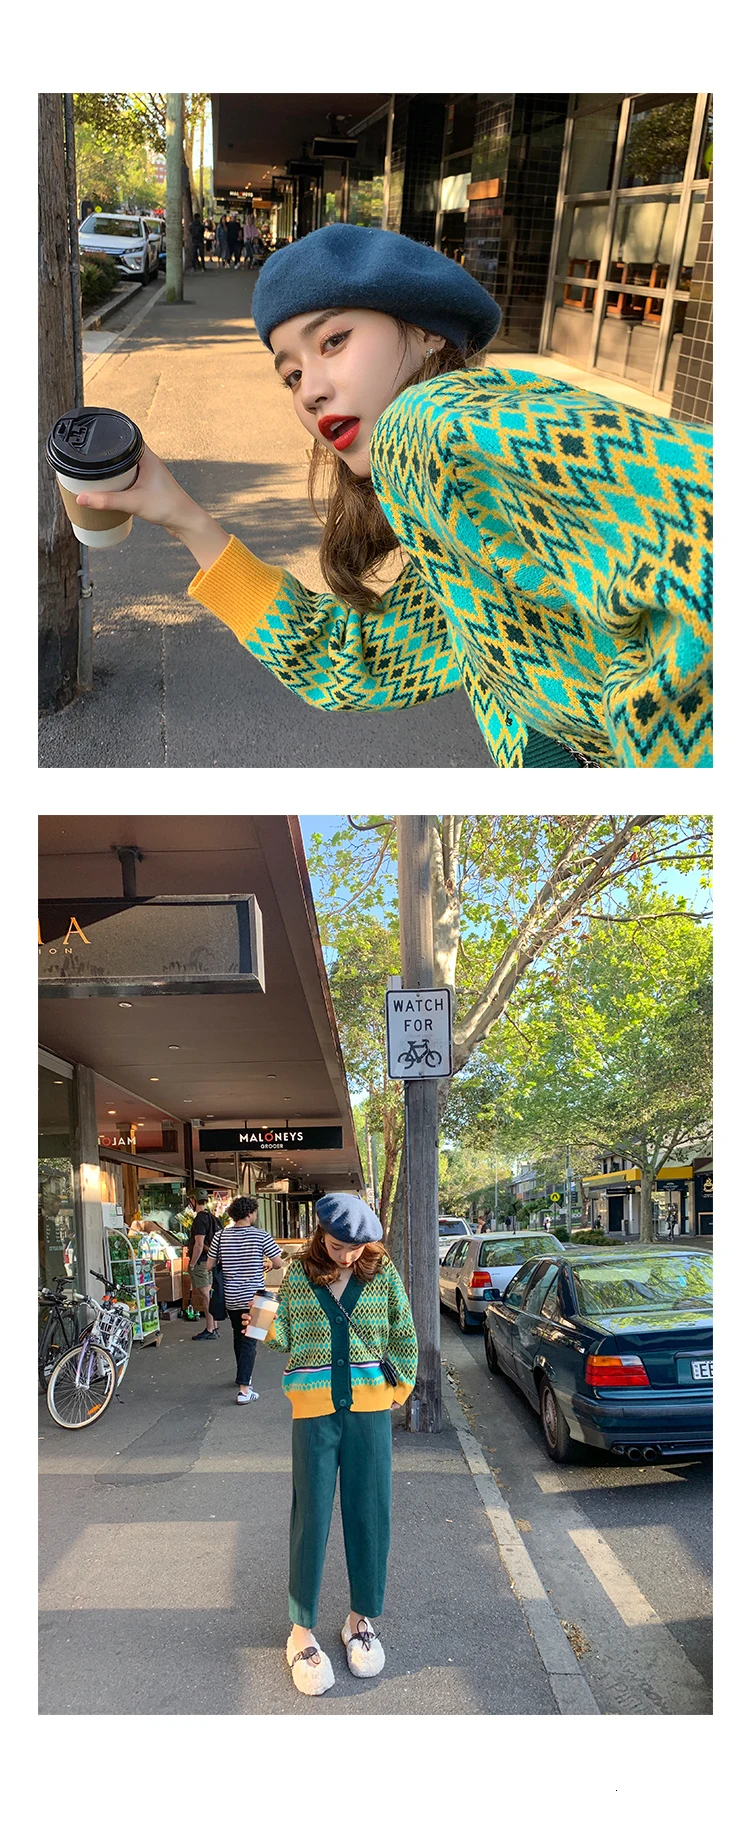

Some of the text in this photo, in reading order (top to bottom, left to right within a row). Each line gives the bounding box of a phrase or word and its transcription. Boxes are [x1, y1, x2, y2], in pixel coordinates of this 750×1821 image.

[38, 916, 91, 945] A
[393, 998, 444, 1012] WATCH
[404, 1019, 433, 1031] FOR
[239, 1131, 304, 1143] MALONEYS
